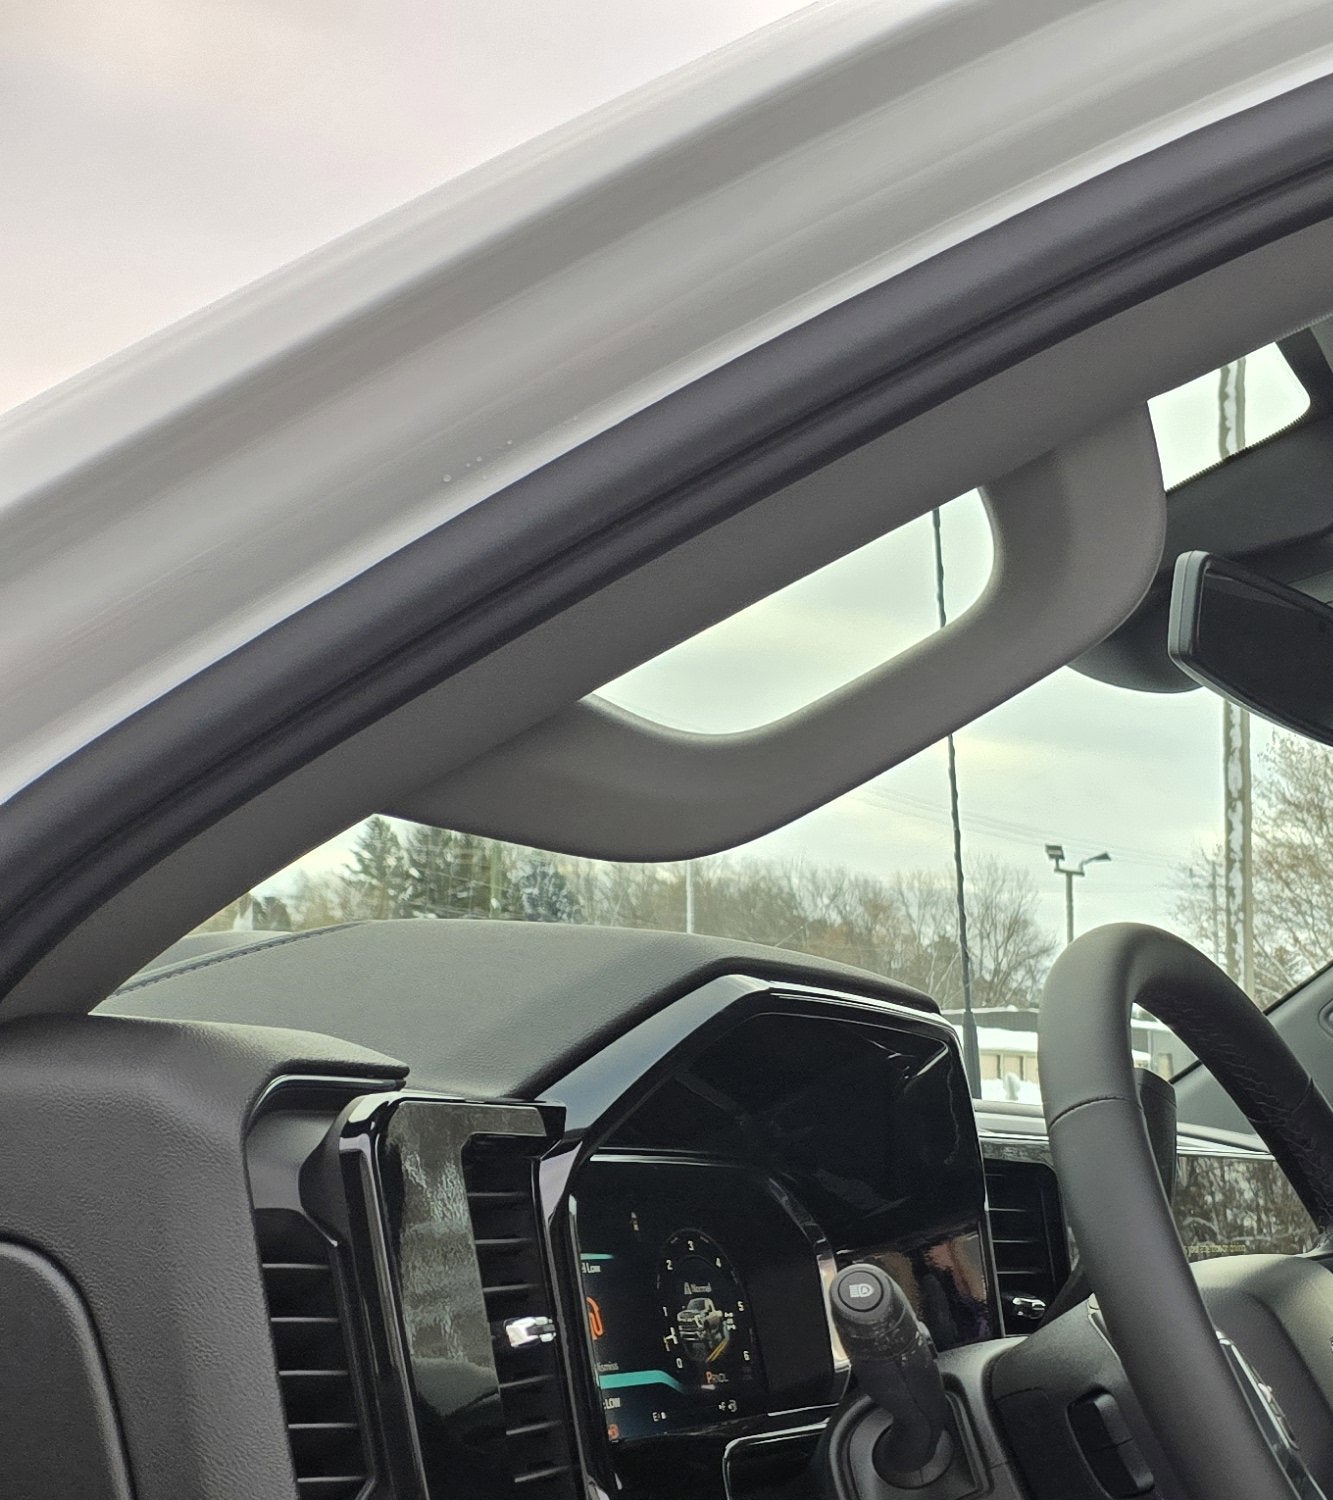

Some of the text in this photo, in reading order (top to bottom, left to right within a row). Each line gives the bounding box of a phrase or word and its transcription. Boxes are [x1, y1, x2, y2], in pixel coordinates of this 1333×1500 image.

[687, 1240, 695, 1251] 3
[666, 1259, 673, 1271] 2
[715, 1257, 722, 1268] 4
[737, 1300, 744, 1312] 5
[743, 1350, 750, 1361] 6
[676, 1357, 683, 1369] 0
